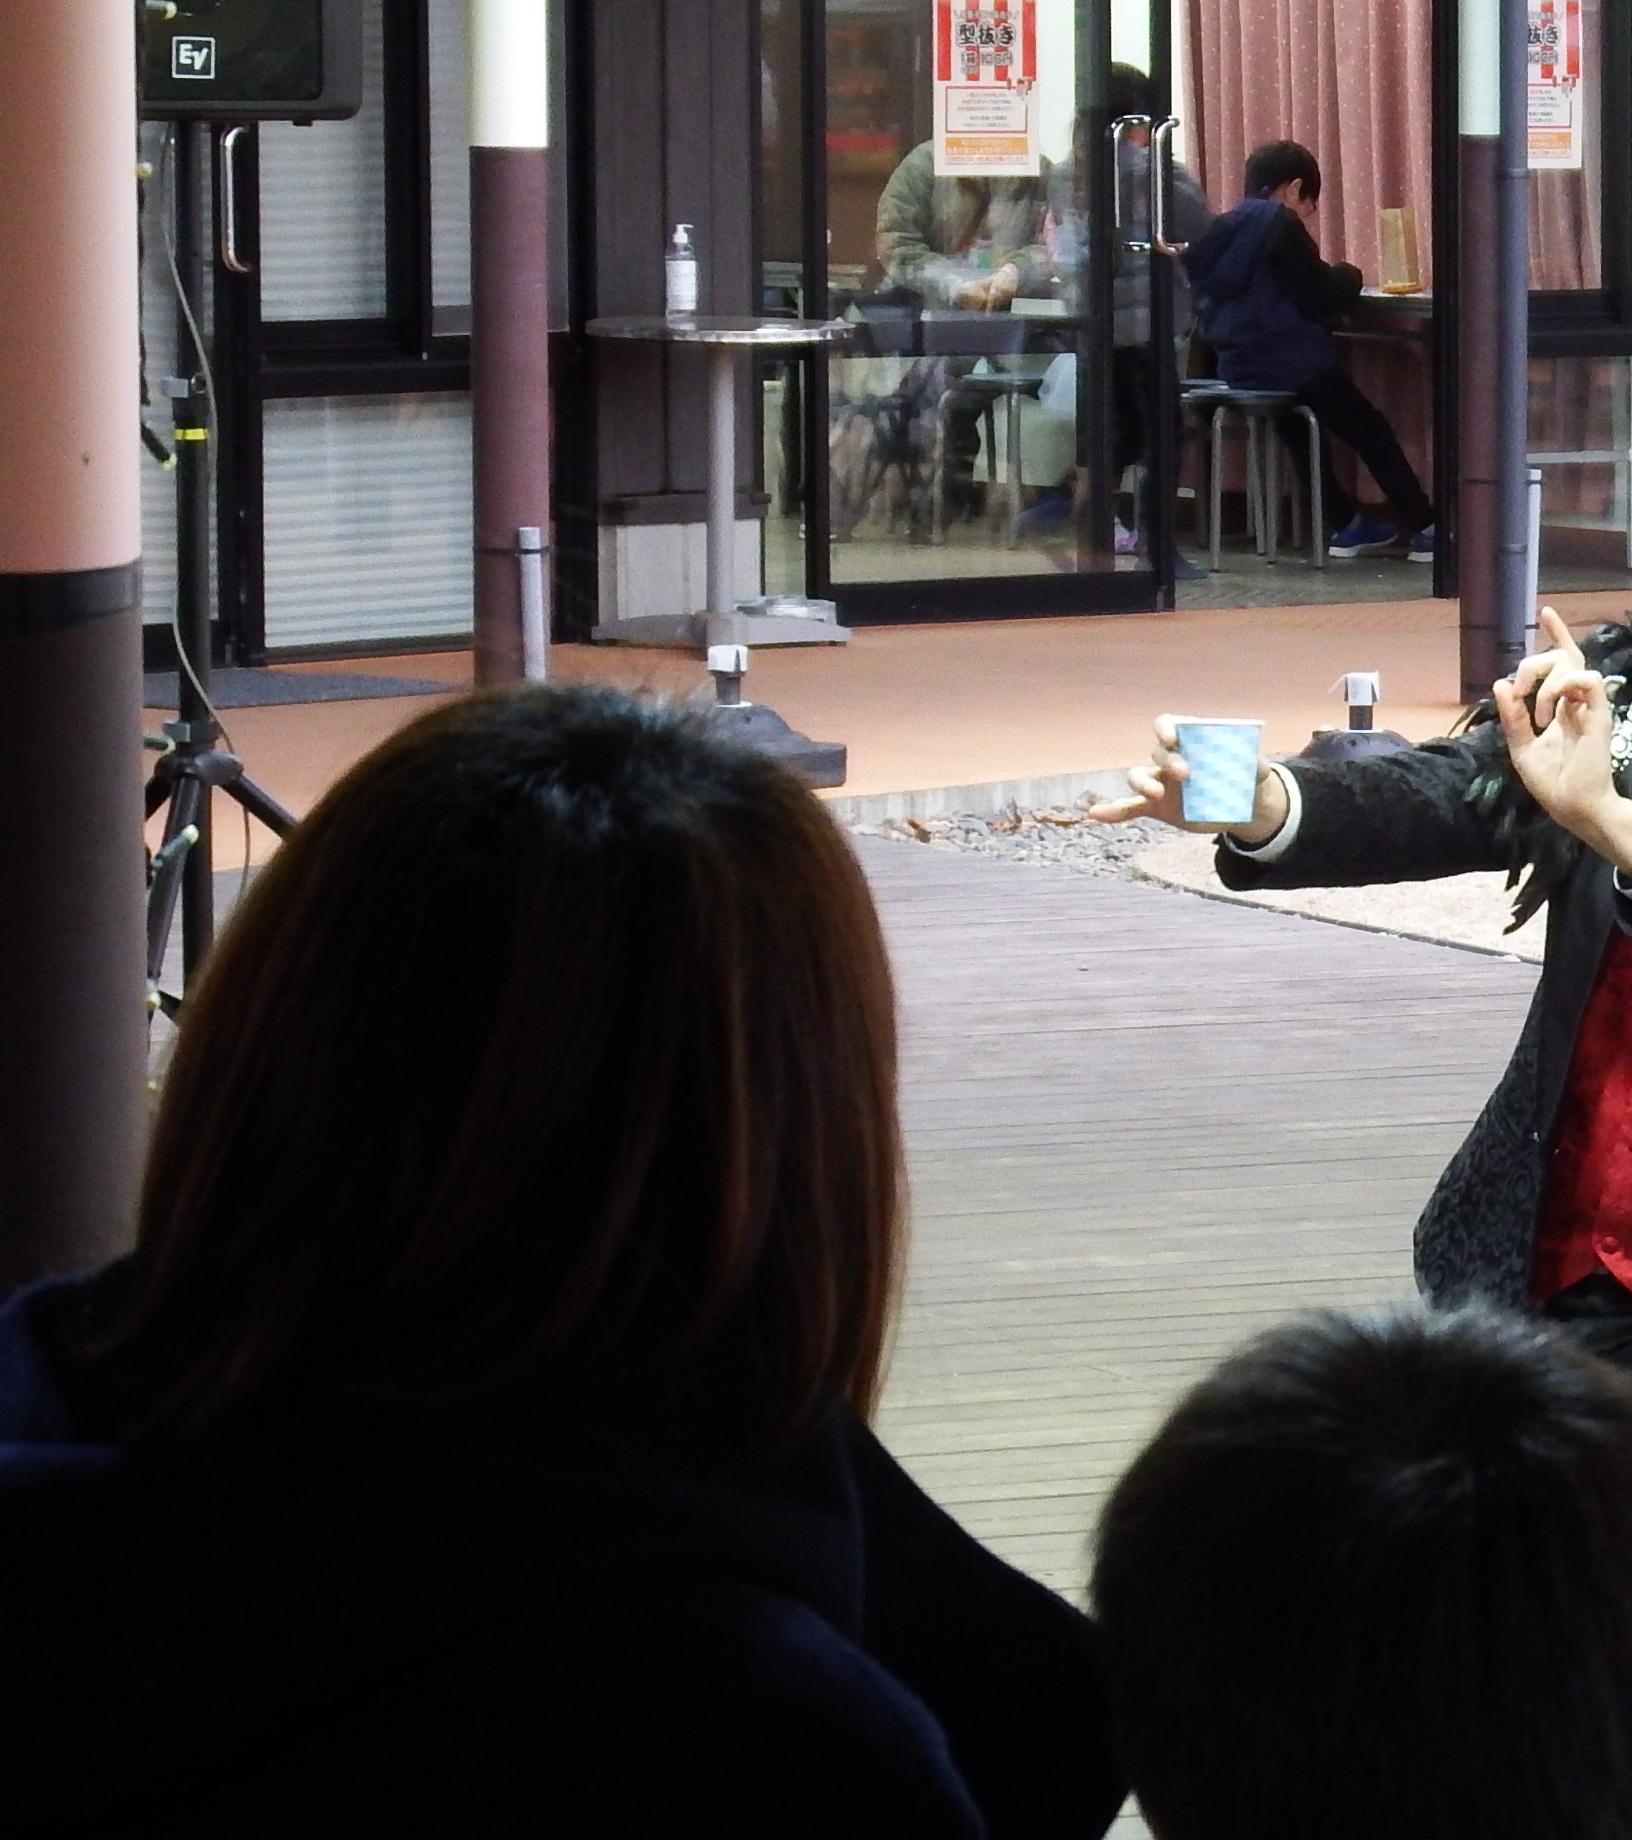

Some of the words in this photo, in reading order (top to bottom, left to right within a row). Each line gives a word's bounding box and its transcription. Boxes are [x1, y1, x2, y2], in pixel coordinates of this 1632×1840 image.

[959, 23, 1014, 45] 型抜き
[179, 43, 209, 71] EV
